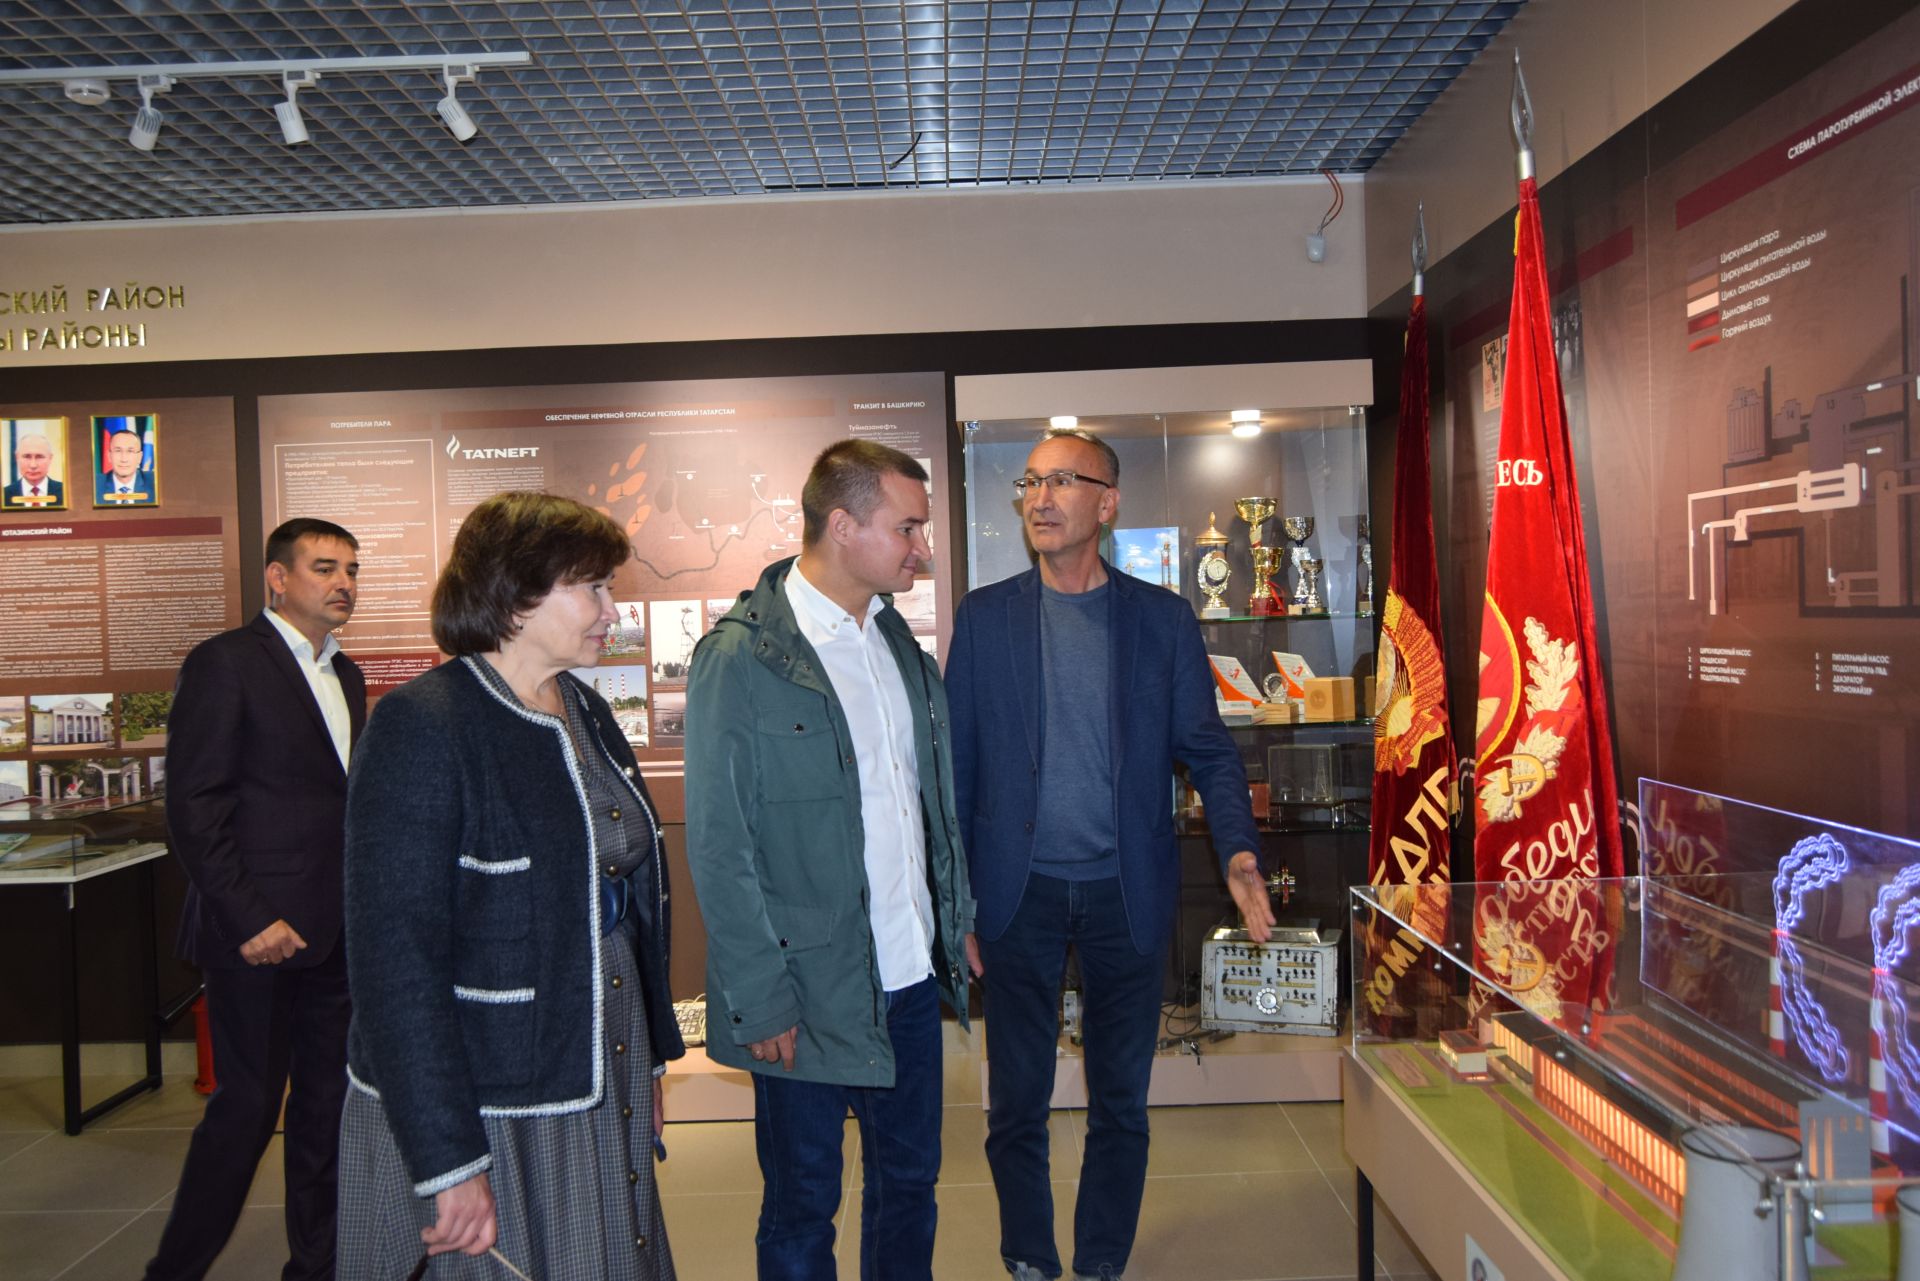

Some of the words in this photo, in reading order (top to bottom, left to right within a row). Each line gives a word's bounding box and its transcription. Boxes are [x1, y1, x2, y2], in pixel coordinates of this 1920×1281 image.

[1787, 136, 1817, 159] СХЕМА
[1817, 90, 1893, 143] ПАРОТУРБИННОЙ
[86, 281, 185, 311] РАЙОН
[23, 321, 146, 351] РАЙОНЫ
[853, 402, 880, 410] ТРАНЗИТ
[887, 401, 926, 409] БАШКИРИЮ
[545, 412, 590, 421] ОБЕСПЕЧЕНИЕ
[625, 410, 656, 419] ОТРАСЛИ
[657, 409, 699, 418] РЕСПУБЛИКИ
[699, 408, 736, 416] ТАТАРСТАН
[373, 420, 392, 428] ПАРА
[462, 447, 540, 460] TATNEFT
[1496, 458, 1544, 487] ЕСЬ
[49, 526, 72, 535] РАЙОН
